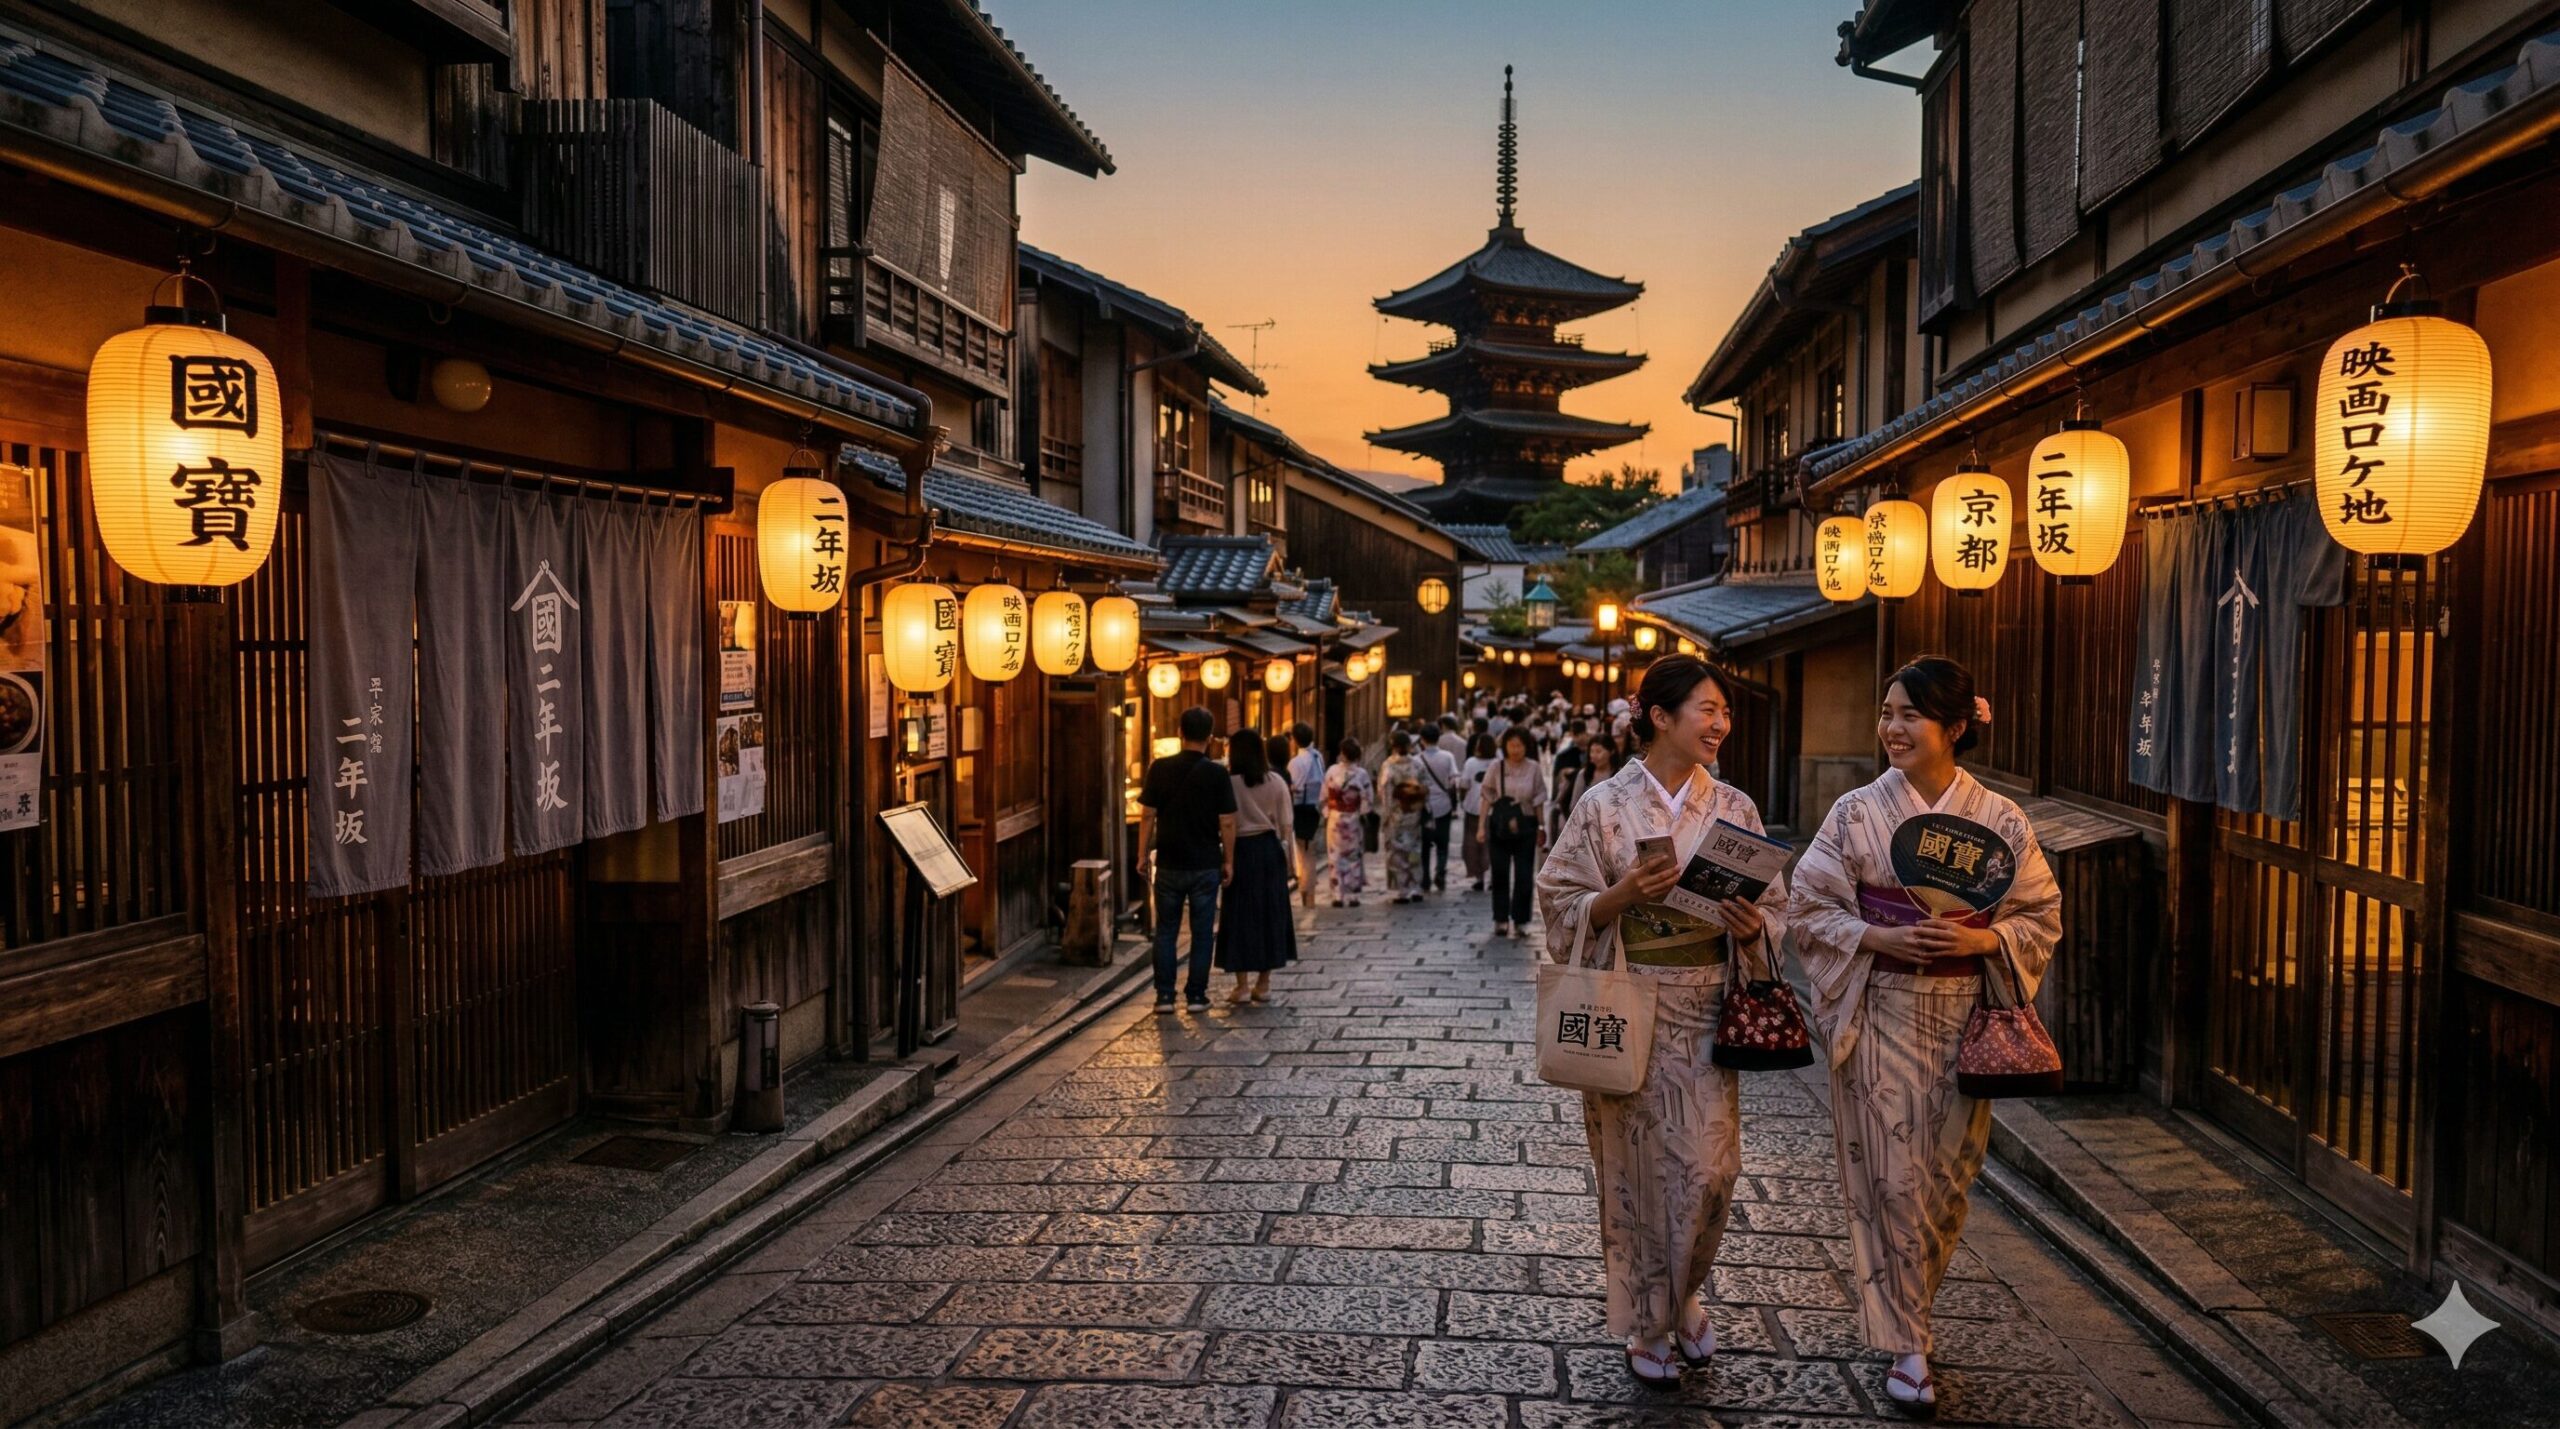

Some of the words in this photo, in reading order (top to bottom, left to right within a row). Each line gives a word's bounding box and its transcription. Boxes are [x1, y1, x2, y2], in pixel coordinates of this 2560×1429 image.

[169, 354, 262, 552] 國寶
[2340, 342, 2396, 524] 映画ロケ地
[811, 497, 845, 594] 二年坂
[1956, 489, 1999, 573] 京都
[2036, 452, 2075, 554] 二年坂
[934, 598, 956, 678] 國寶
[335, 717, 368, 845] 二年坂
[1917, 827, 1984, 876] 國寶
[1558, 1011, 1628, 1053] 國寶
